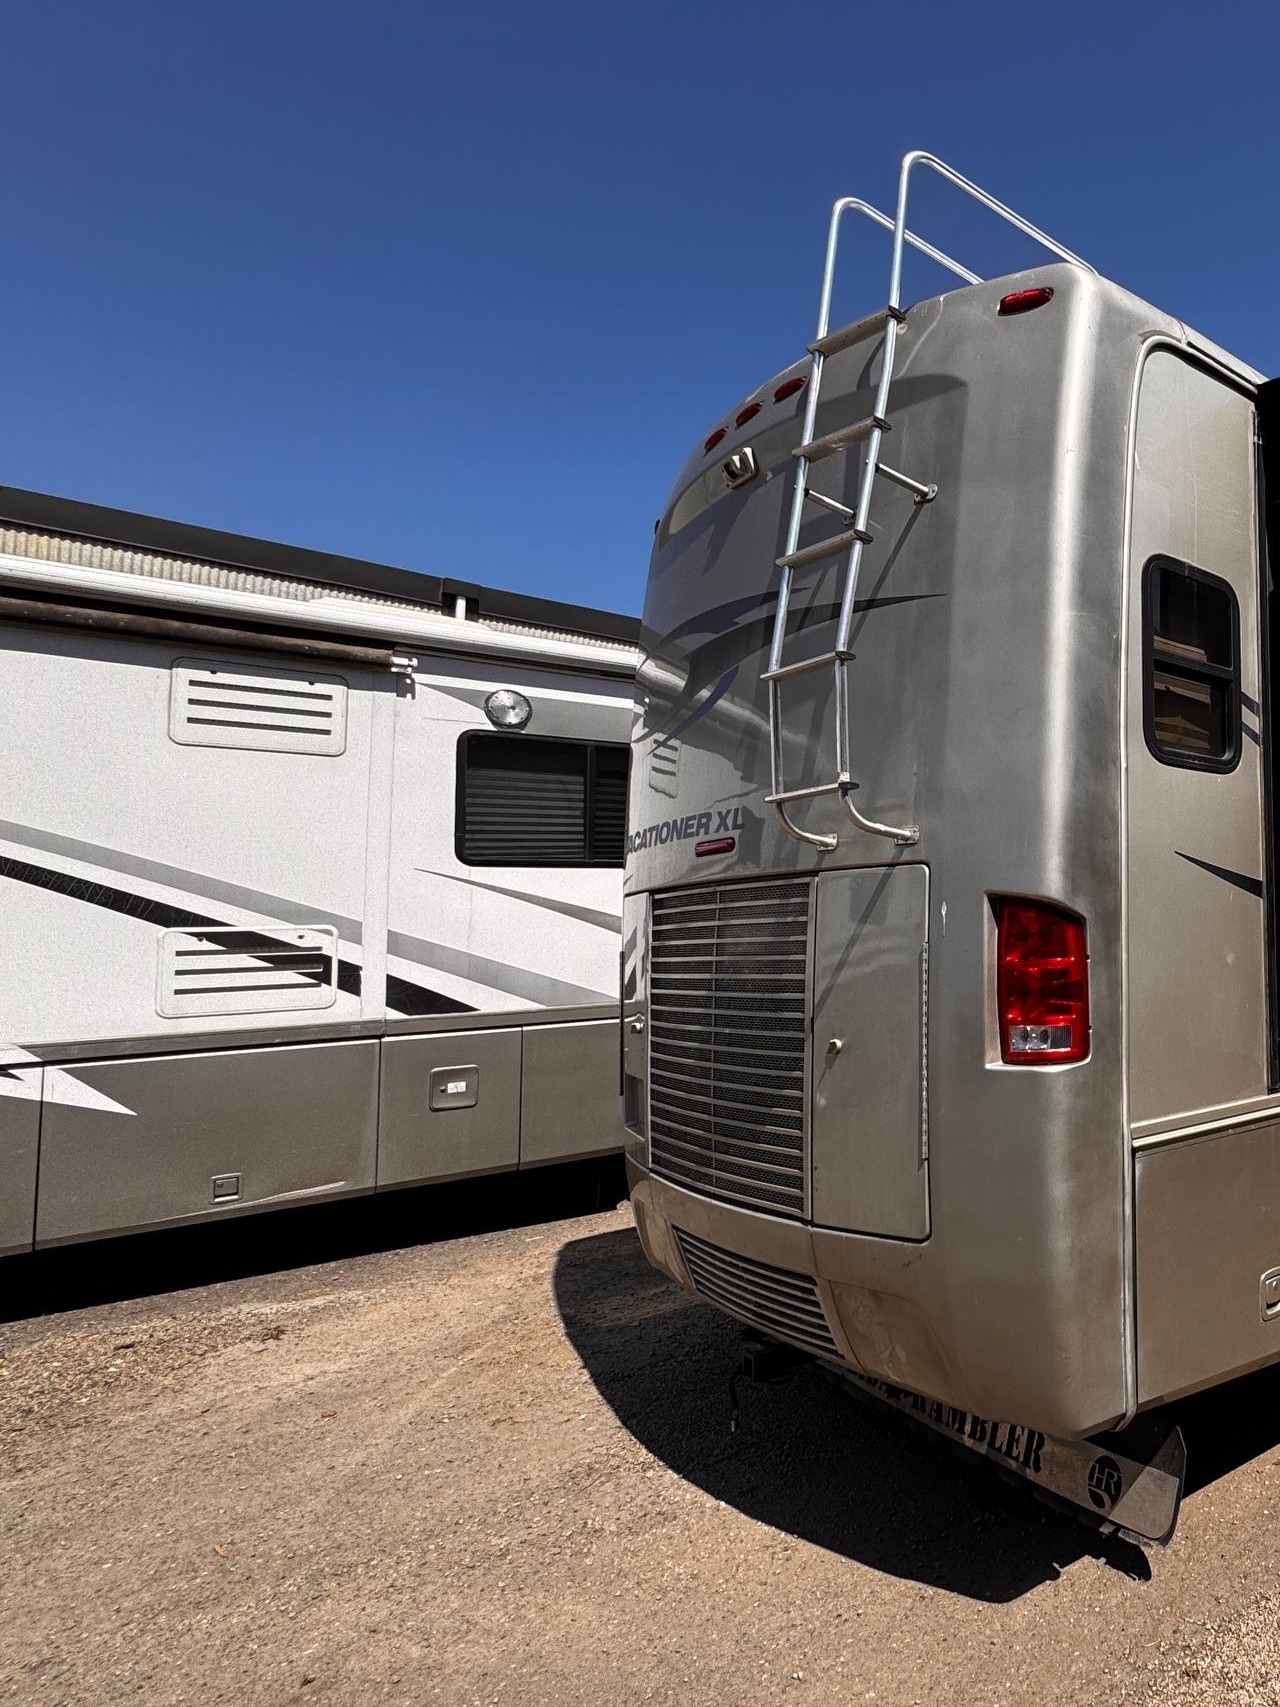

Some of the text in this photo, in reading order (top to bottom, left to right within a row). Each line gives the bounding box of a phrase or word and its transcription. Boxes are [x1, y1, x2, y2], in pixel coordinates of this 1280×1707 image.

[626, 807, 745, 855] ACATIONER XL
[1088, 1461, 1121, 1496] HR
